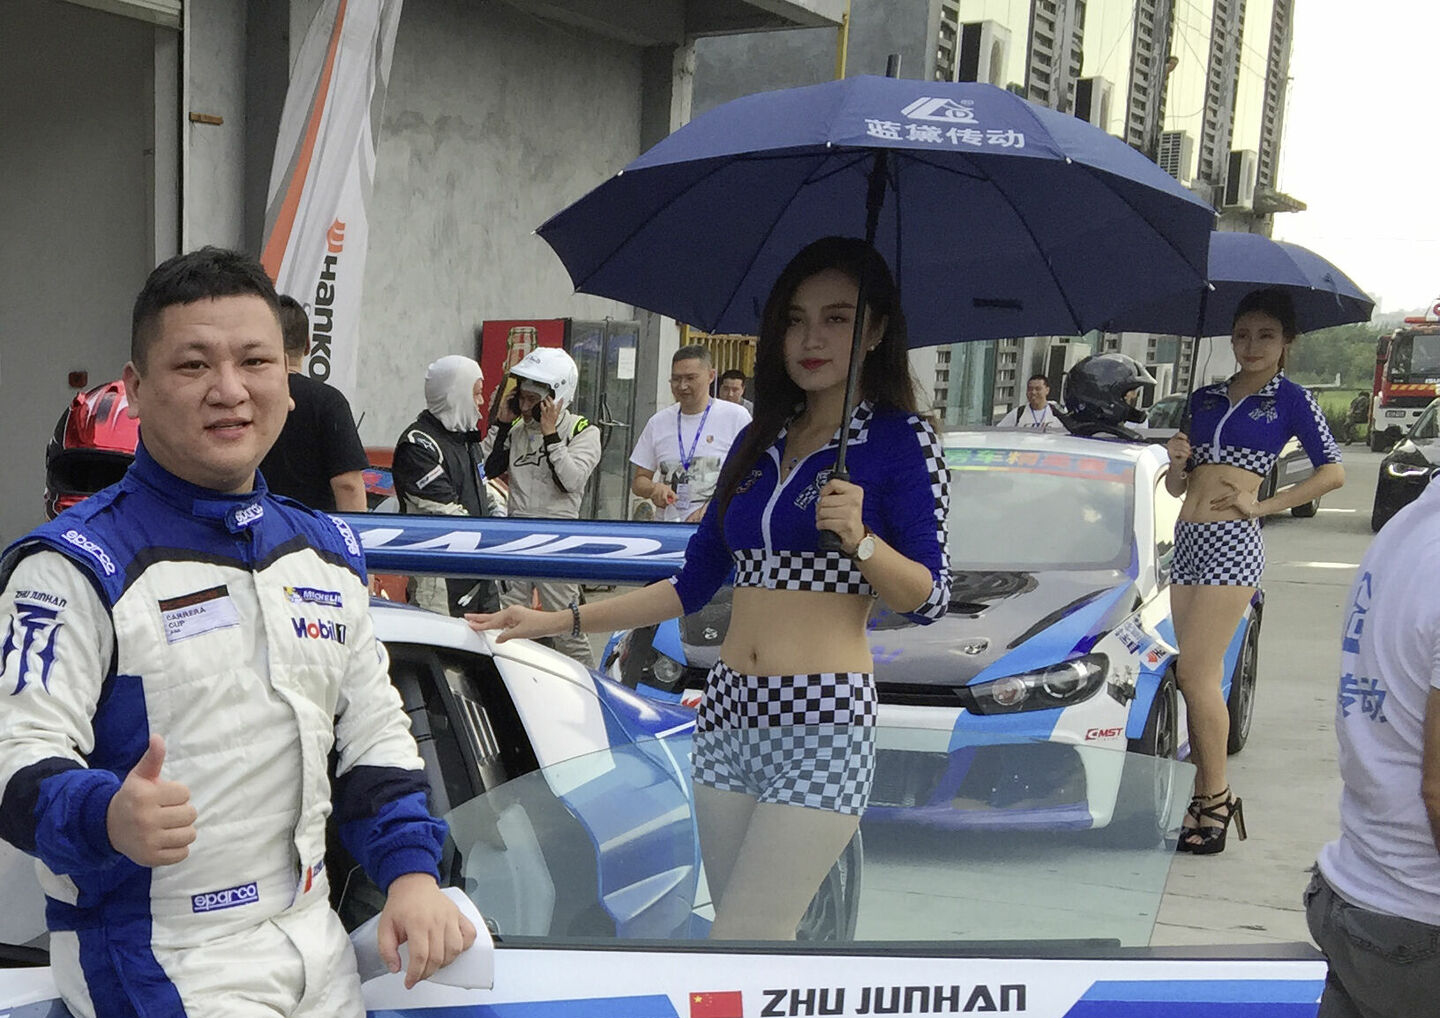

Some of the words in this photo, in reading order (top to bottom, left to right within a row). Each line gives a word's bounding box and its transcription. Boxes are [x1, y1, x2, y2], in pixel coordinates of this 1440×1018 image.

[864, 118, 1026, 149] 蓝黛传动
[761, 988, 844, 1017] ZHU
[855, 984, 1026, 1014] JUNHAN
